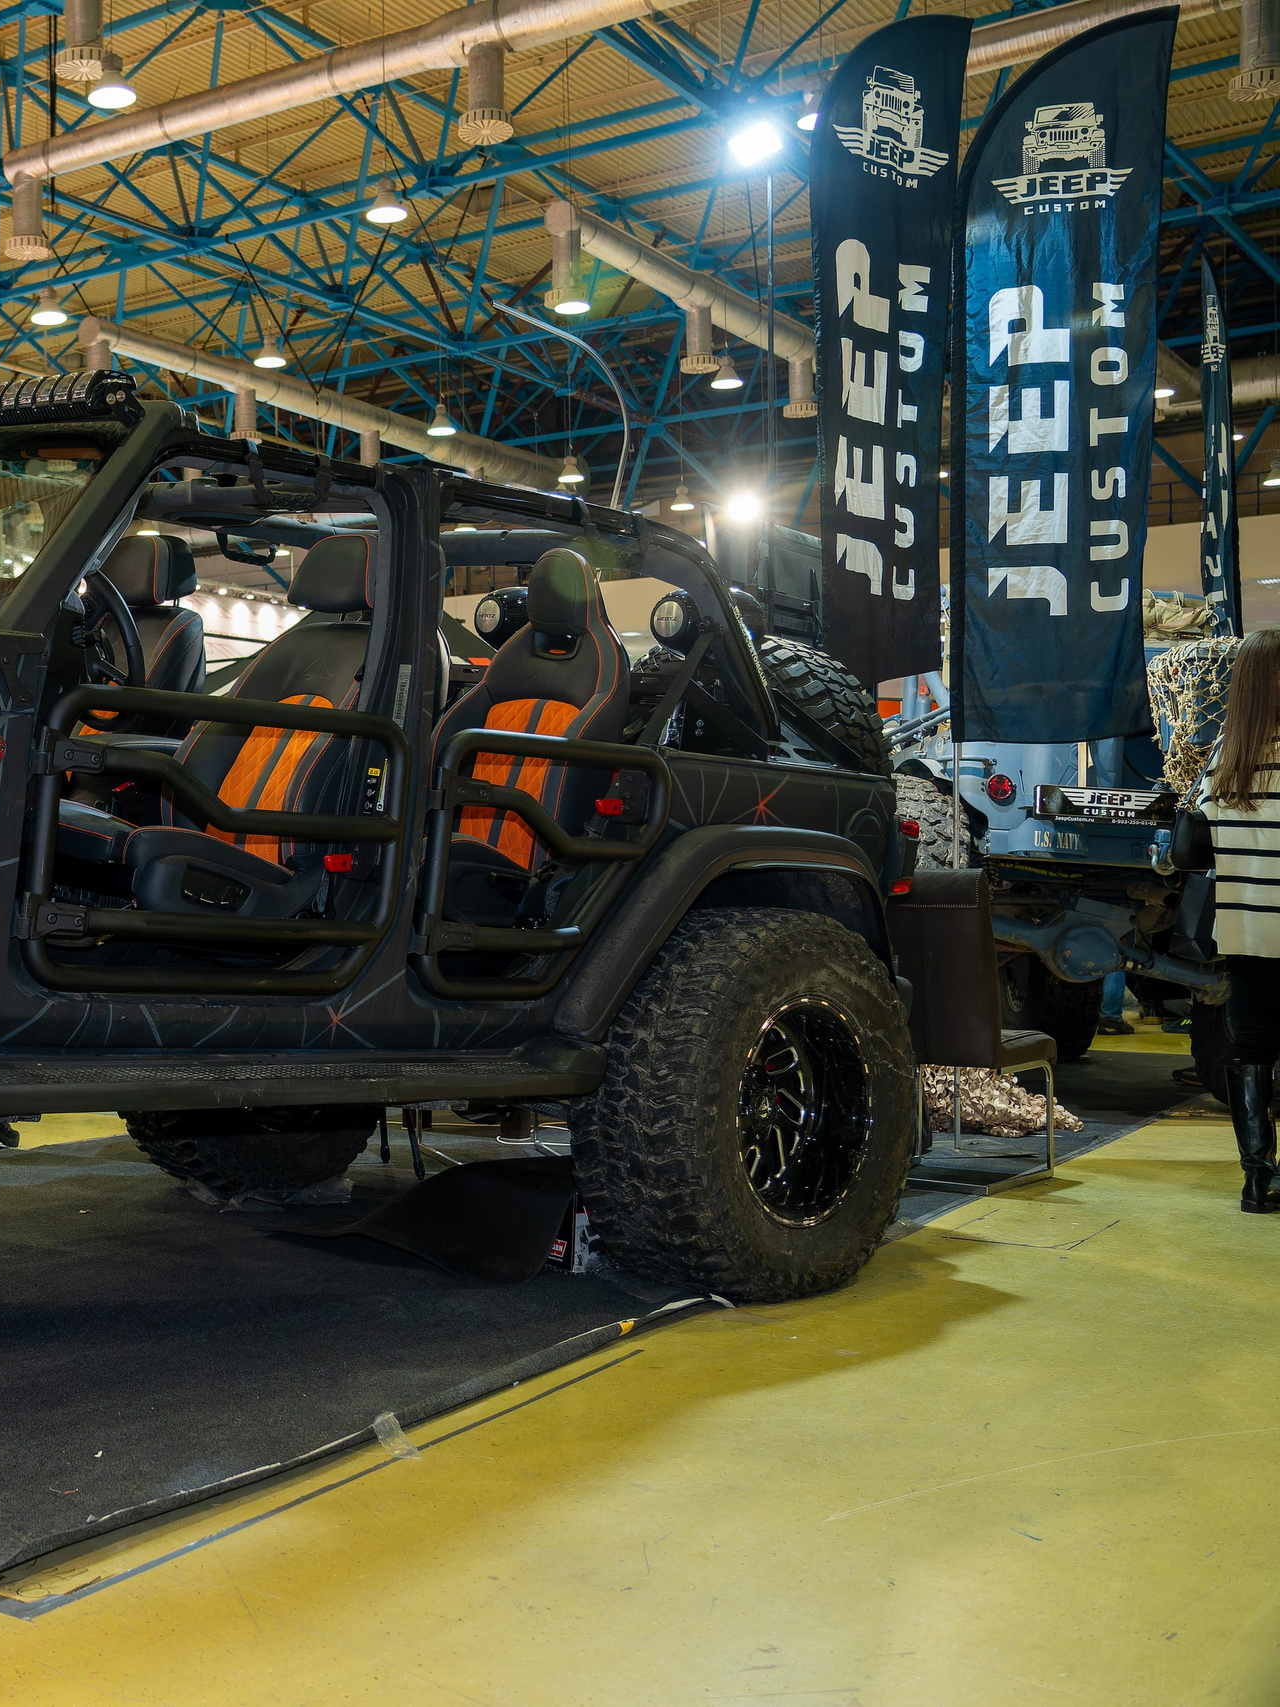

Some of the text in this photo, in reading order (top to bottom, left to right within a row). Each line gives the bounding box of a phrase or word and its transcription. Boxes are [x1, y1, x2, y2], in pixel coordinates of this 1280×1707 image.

[864, 136, 915, 169] JEEP
[862, 161, 919, 189] CUSTOM
[1020, 171, 1109, 198] JEEP
[1023, 199, 1107, 217] CUSTOM
[834, 238, 891, 596] JEEP
[891, 262, 932, 601] CUSTOM
[987, 284, 1071, 617] JEEP
[1088, 281, 1130, 613] CUSTOM
[1083, 808, 1136, 818] CUSTOM
[1086, 791, 1133, 807] JEEP
[1034, 830, 1081, 850] U.S. NAVY
